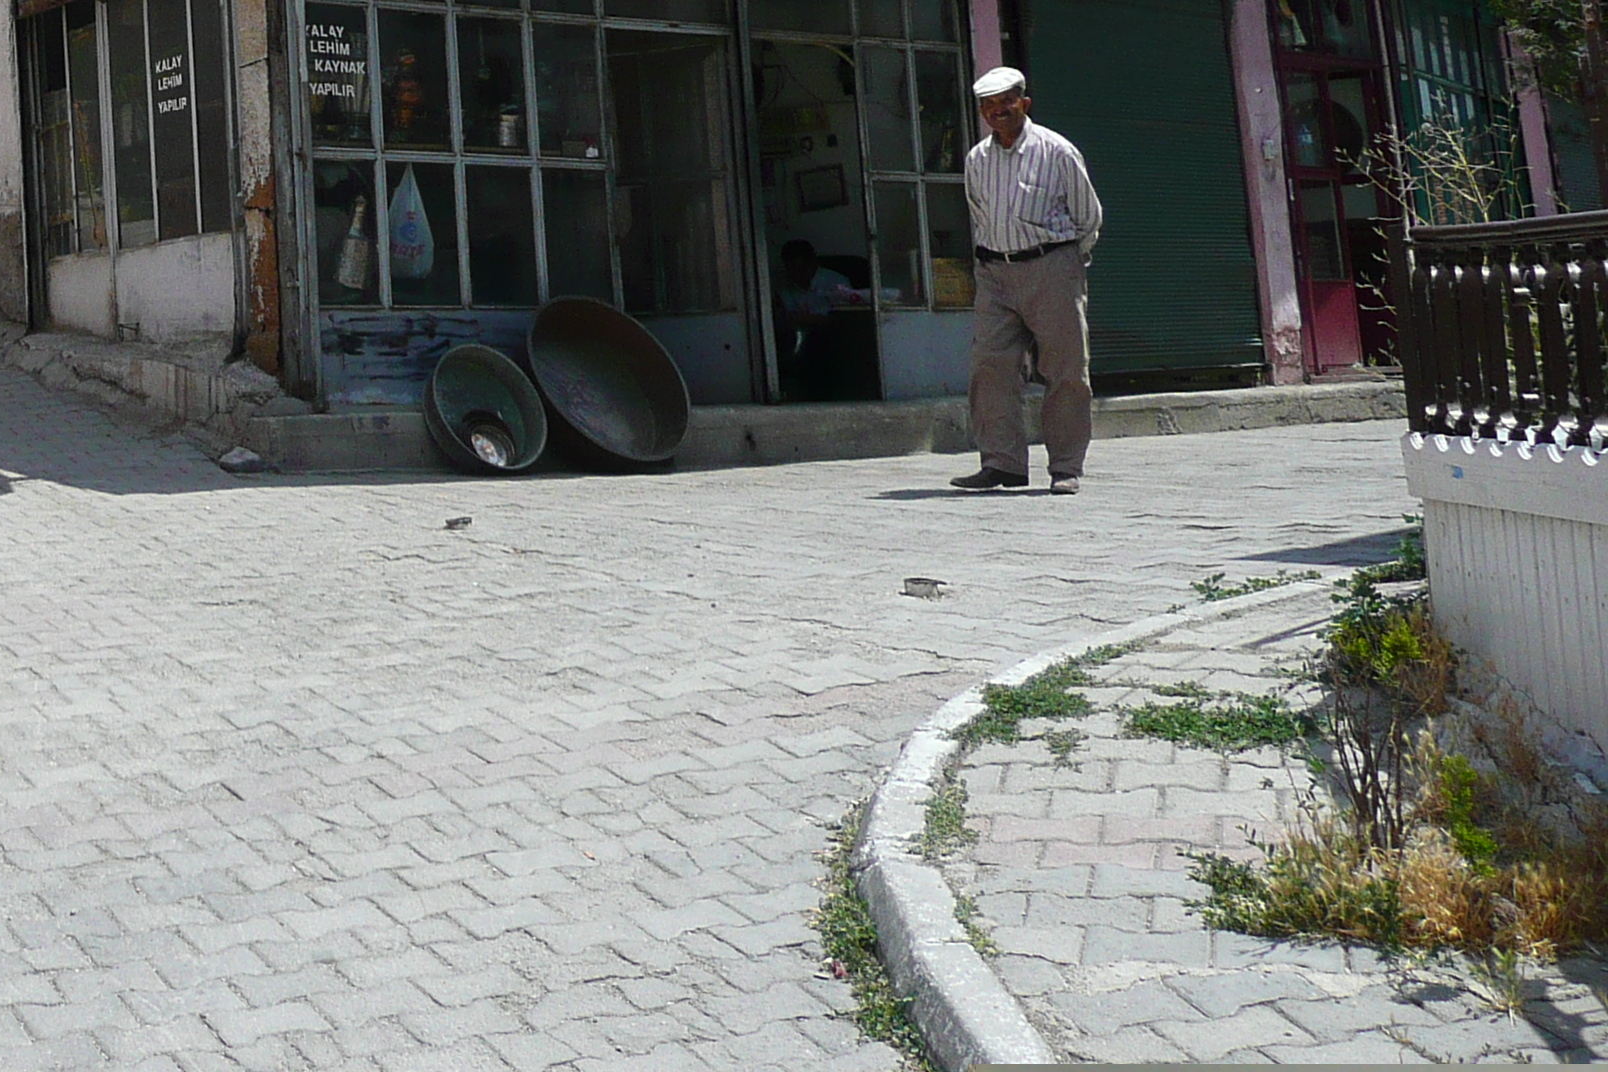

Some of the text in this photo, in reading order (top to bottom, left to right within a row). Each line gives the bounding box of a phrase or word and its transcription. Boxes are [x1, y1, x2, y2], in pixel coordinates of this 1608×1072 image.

[310, 38, 350, 56] LEHİM
[155, 54, 182, 74] KALAY
[314, 59, 366, 75] KAYNAK
[157, 72, 182, 91] LEHİM
[309, 82, 355, 98] YAPILIR
